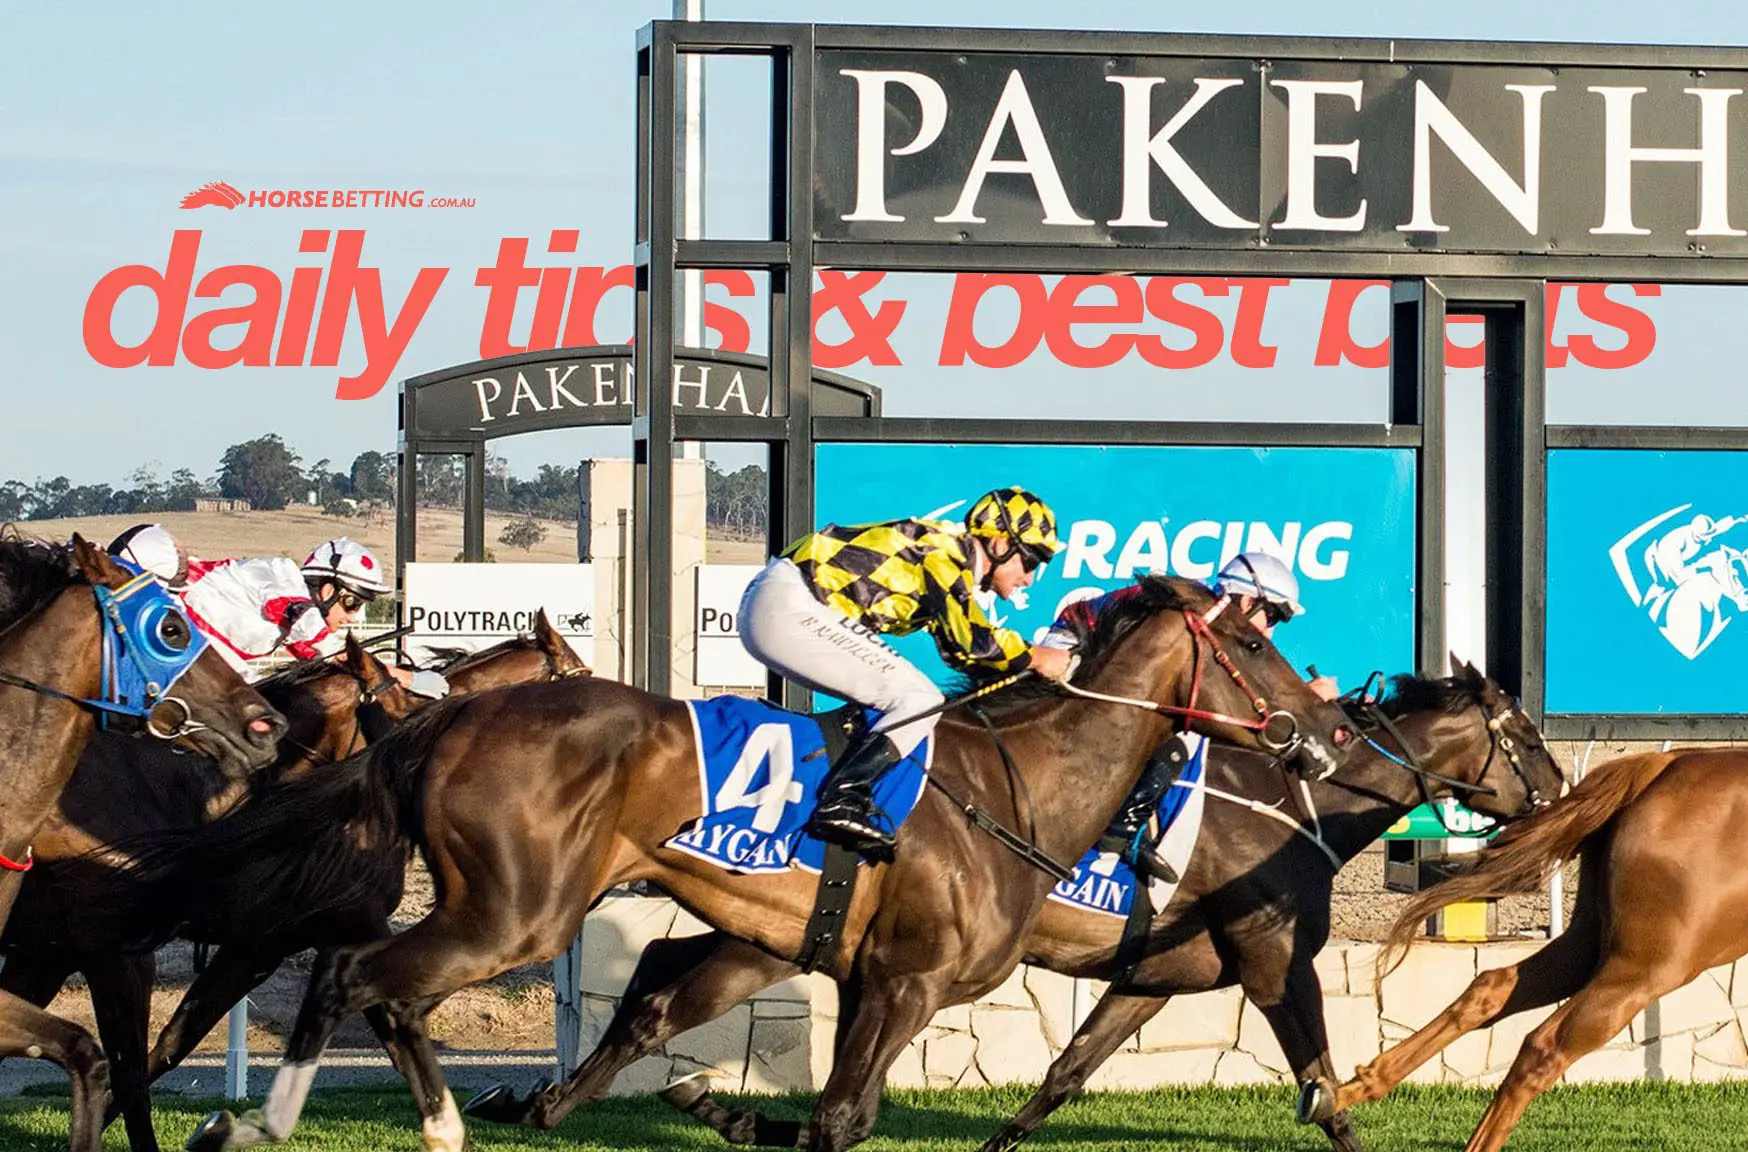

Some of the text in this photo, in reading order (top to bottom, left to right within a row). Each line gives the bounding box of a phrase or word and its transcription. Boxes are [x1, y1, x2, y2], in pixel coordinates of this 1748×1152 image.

[472, 362, 771, 423] PAKEHA
[1062, 520, 1353, 581] RACING
[716, 723, 804, 834] 4
